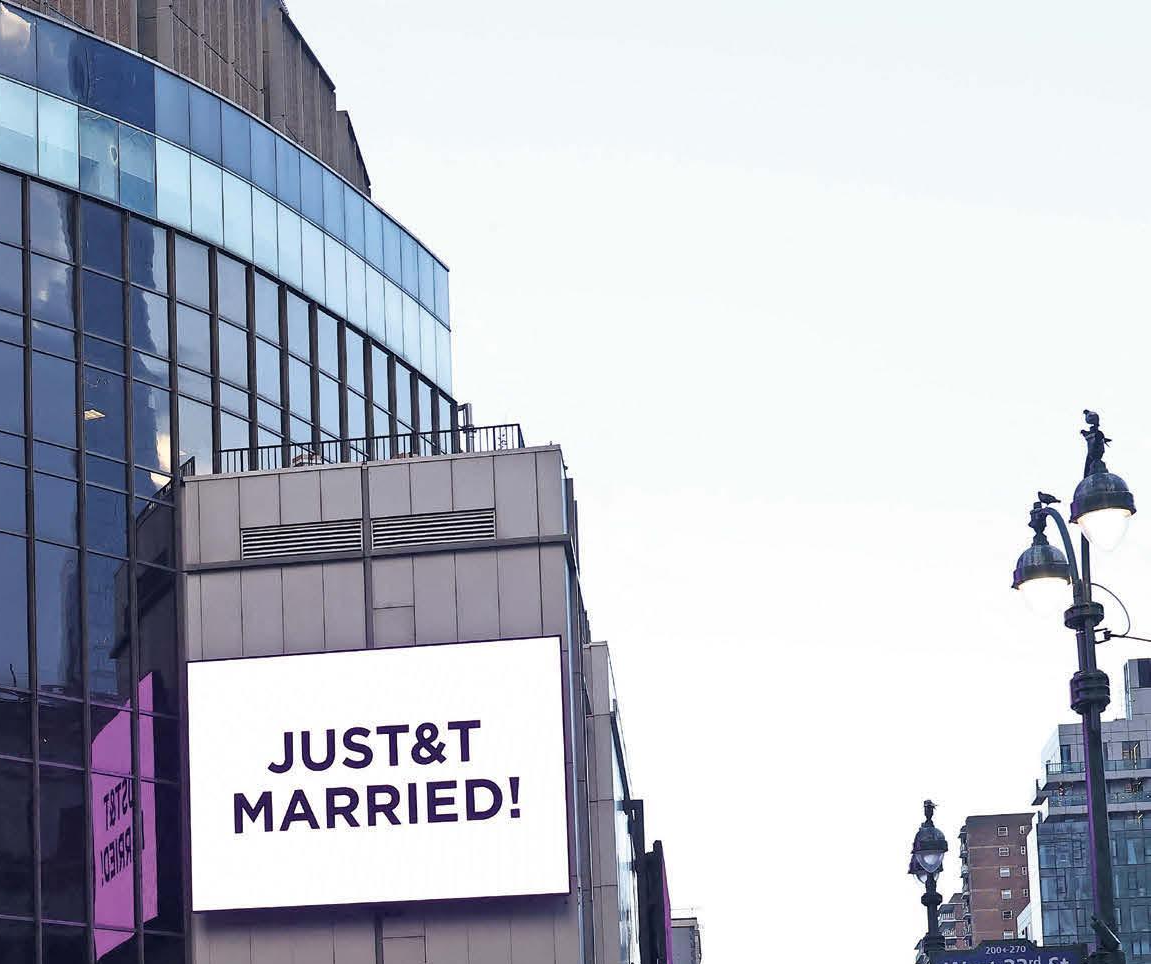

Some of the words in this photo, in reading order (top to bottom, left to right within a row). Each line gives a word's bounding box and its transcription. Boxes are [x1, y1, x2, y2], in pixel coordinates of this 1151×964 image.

[268, 720, 480, 773] JUST&T
[234, 777, 520, 833] MARRIED!
[985, 946, 1002, 954] 200
[1009, 945, 1027, 954] 270
